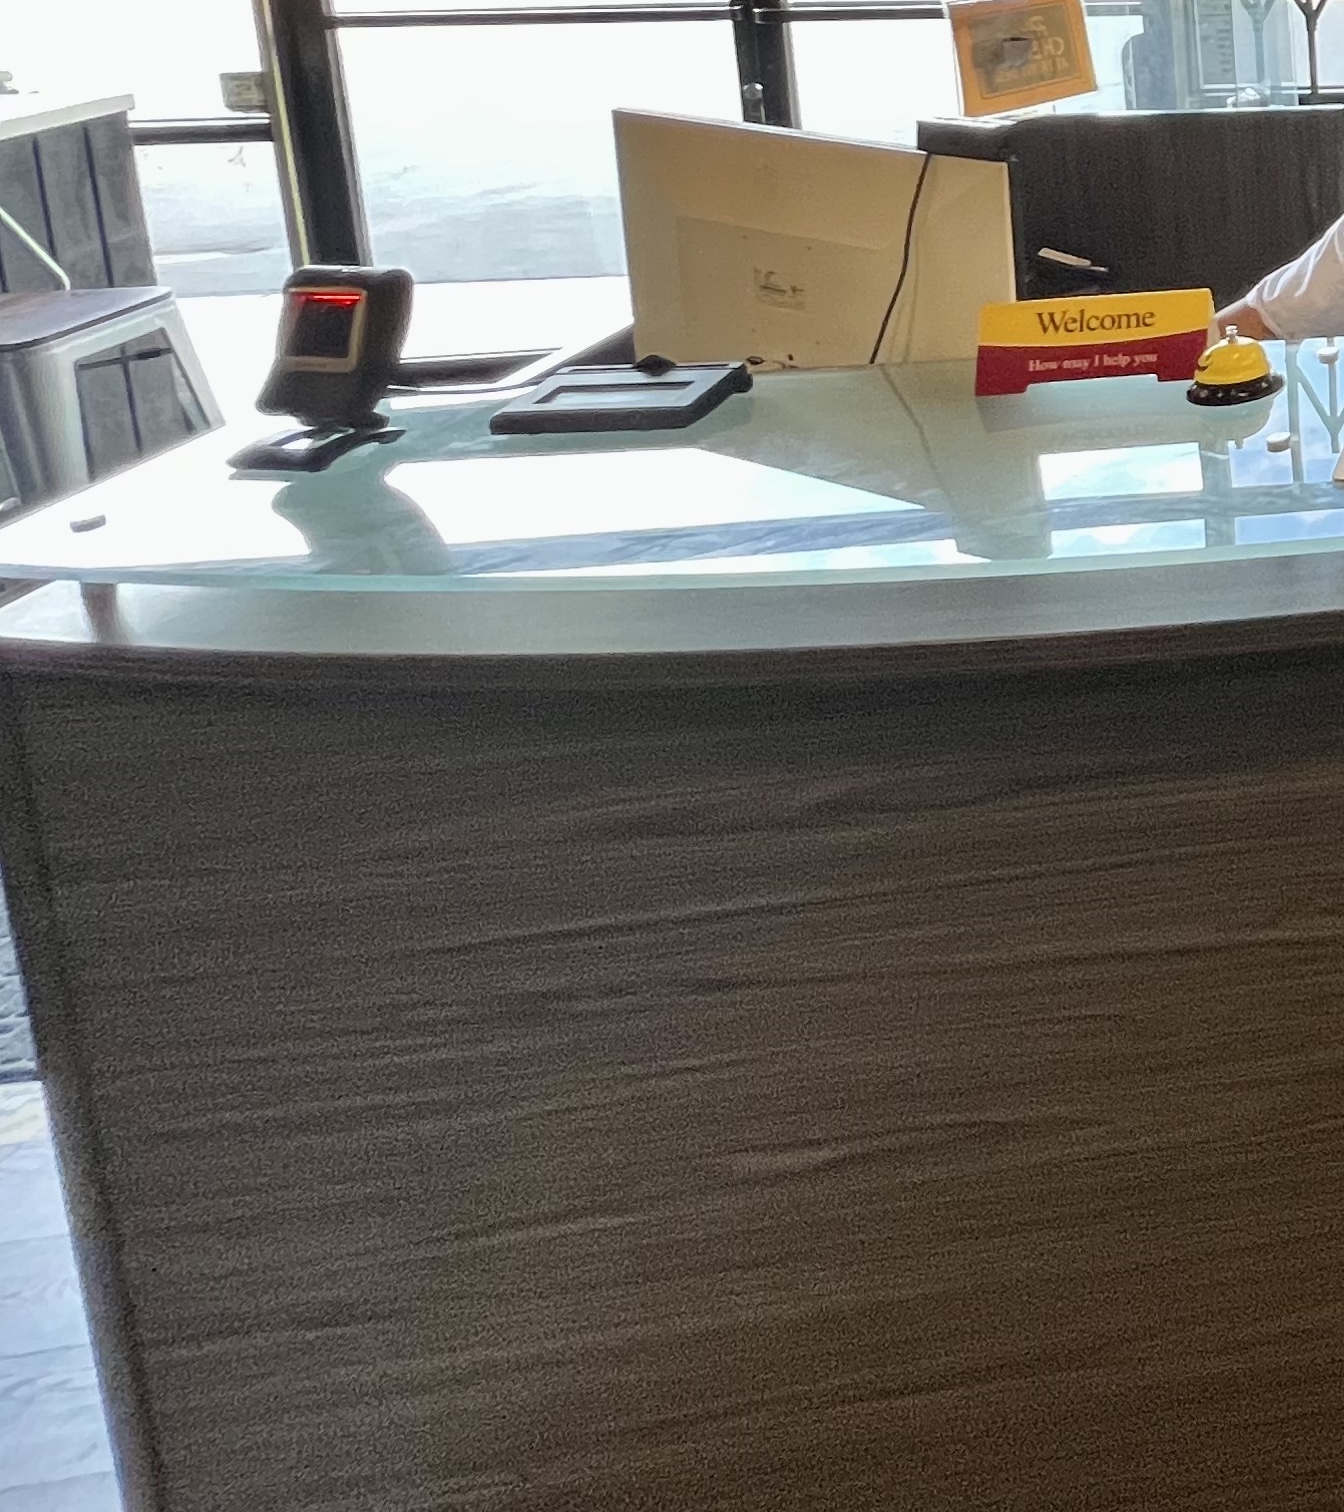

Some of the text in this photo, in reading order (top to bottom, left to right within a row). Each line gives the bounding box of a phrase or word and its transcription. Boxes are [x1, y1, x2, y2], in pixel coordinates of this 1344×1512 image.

[1036, 309, 1157, 334] Welcome
[1028, 358, 1059, 372] How
[1063, 358, 1090, 370] may
[1103, 354, 1132, 368] help
[1133, 352, 1158, 366] you
